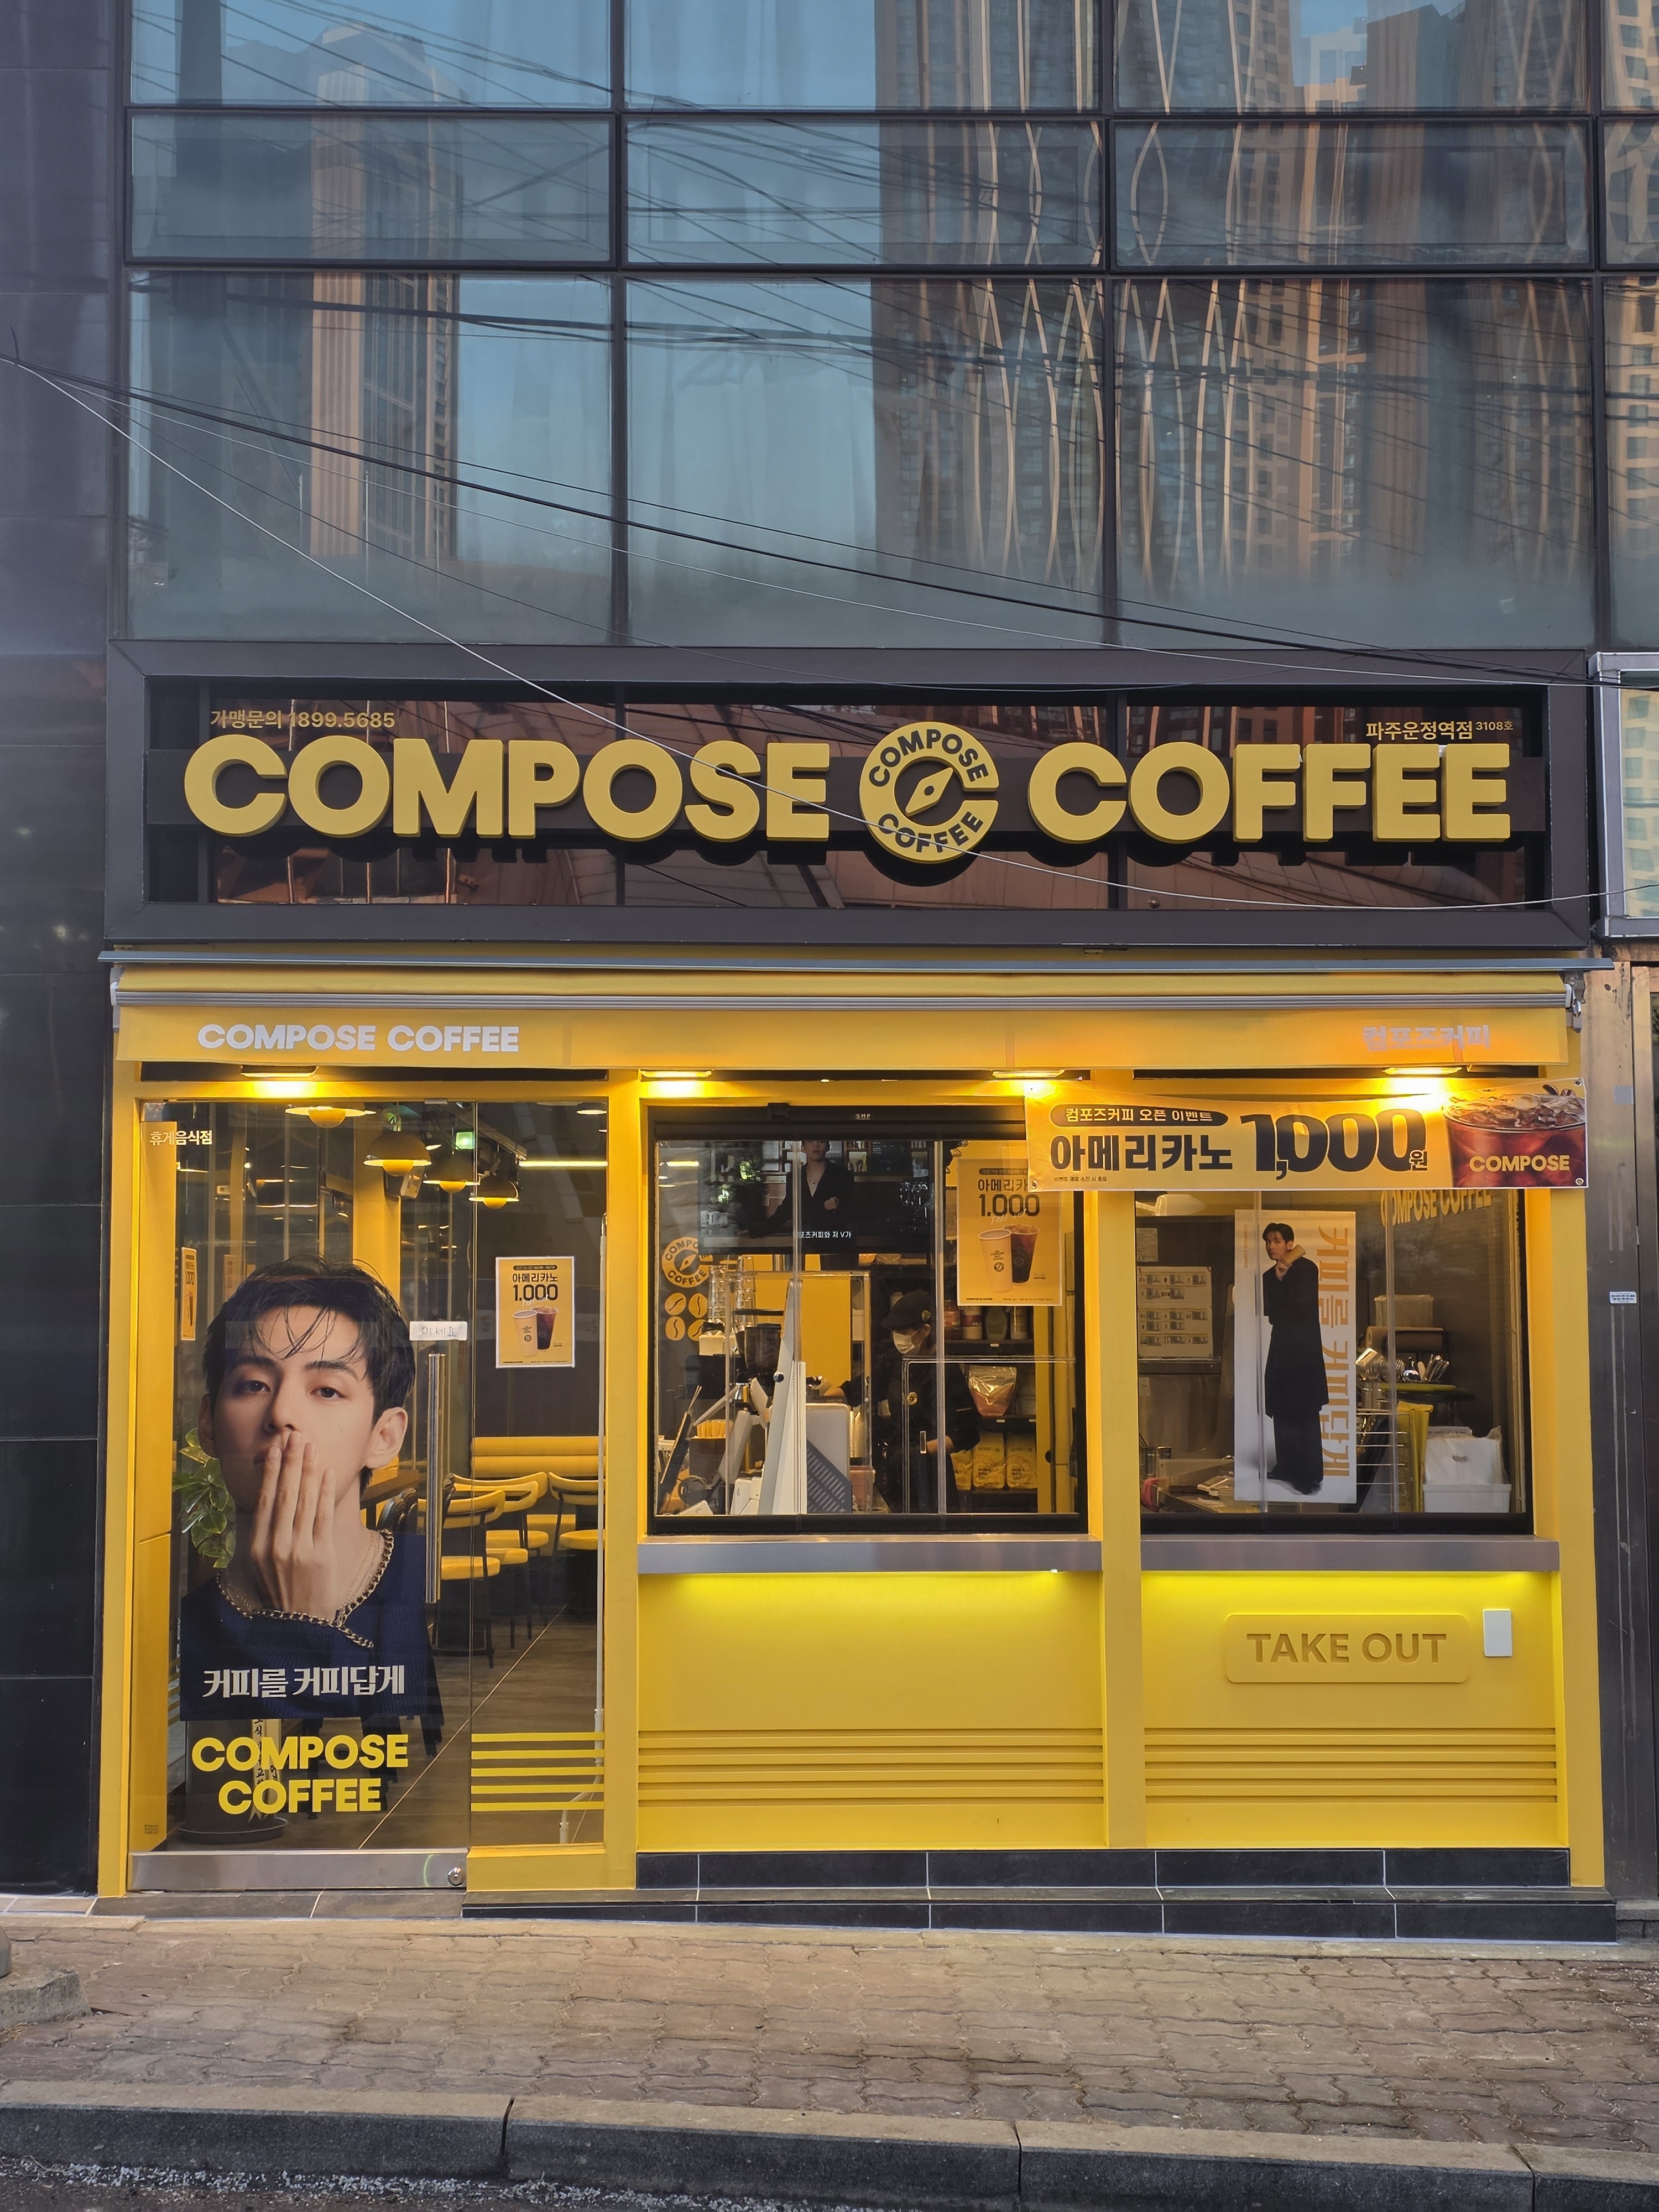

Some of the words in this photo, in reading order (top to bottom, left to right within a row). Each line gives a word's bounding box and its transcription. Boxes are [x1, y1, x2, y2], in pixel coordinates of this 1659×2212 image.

[210, 709, 281, 729] 가맹문의
[288, 712, 395, 728] 1899.5685
[1366, 721, 1473, 740] 파주운정역점
[1475, 721, 1514, 731] 3108호
[868, 728, 989, 787] COMPOSE
[185, 734, 830, 842] COMPOSE
[1027, 742, 1511, 844] COFFEE
[878, 811, 984, 853] COFFEE
[197, 1024, 375, 1051] COMPOSE
[388, 1026, 519, 1052] COFFEE
[1362, 1025, 1491, 1052] 컴포즈커피
[1066, 1108, 1134, 1122] 컴포즈커피
[1140, 1109, 1166, 1121] 오픈
[1172, 1110, 1212, 1122] 이벤트
[149, 1130, 212, 1145] 휴게음식점
[1050, 1135, 1233, 1171] 아메리카노
[1469, 1155, 1570, 1172] COMPOSE
[978, 1178, 1029, 1192] 아메리카
[665, 1240, 708, 1261] COMPO
[512, 1273, 558, 1283] 아메리카노
[668, 1270, 707, 1285] COFFEE
[1317, 1225, 1349, 1328] 커피를
[1246, 1633, 1350, 1663] TAKE
[1362, 1633, 1447, 1663] OUT
[202, 1669, 289, 1698] 커피를
[293, 1666, 405, 1695] 커피답게
[191, 1734, 409, 1772] COMPOSE
[218, 1778, 382, 1814] COFFEE
